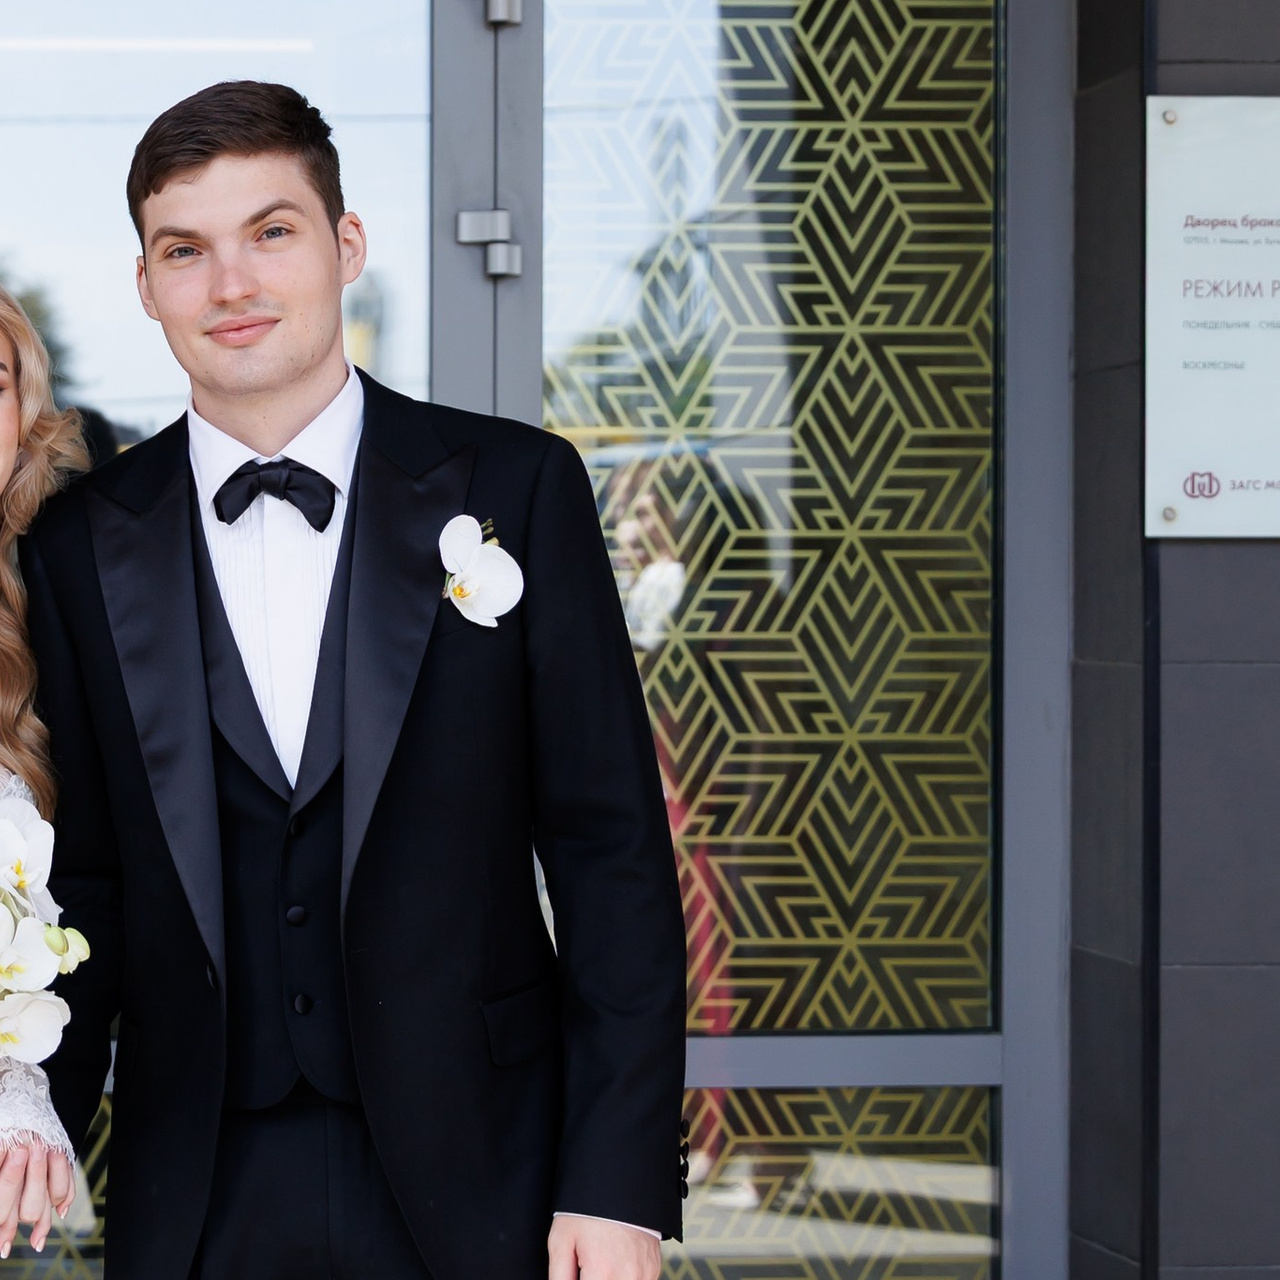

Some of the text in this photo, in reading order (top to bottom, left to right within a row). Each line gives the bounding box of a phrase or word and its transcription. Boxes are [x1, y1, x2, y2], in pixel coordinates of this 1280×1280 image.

[1184, 215, 1237, 229] Дворец
[1182, 279, 1263, 298] РЕЖИМ
[1230, 480, 1262, 490] ЗАГС
